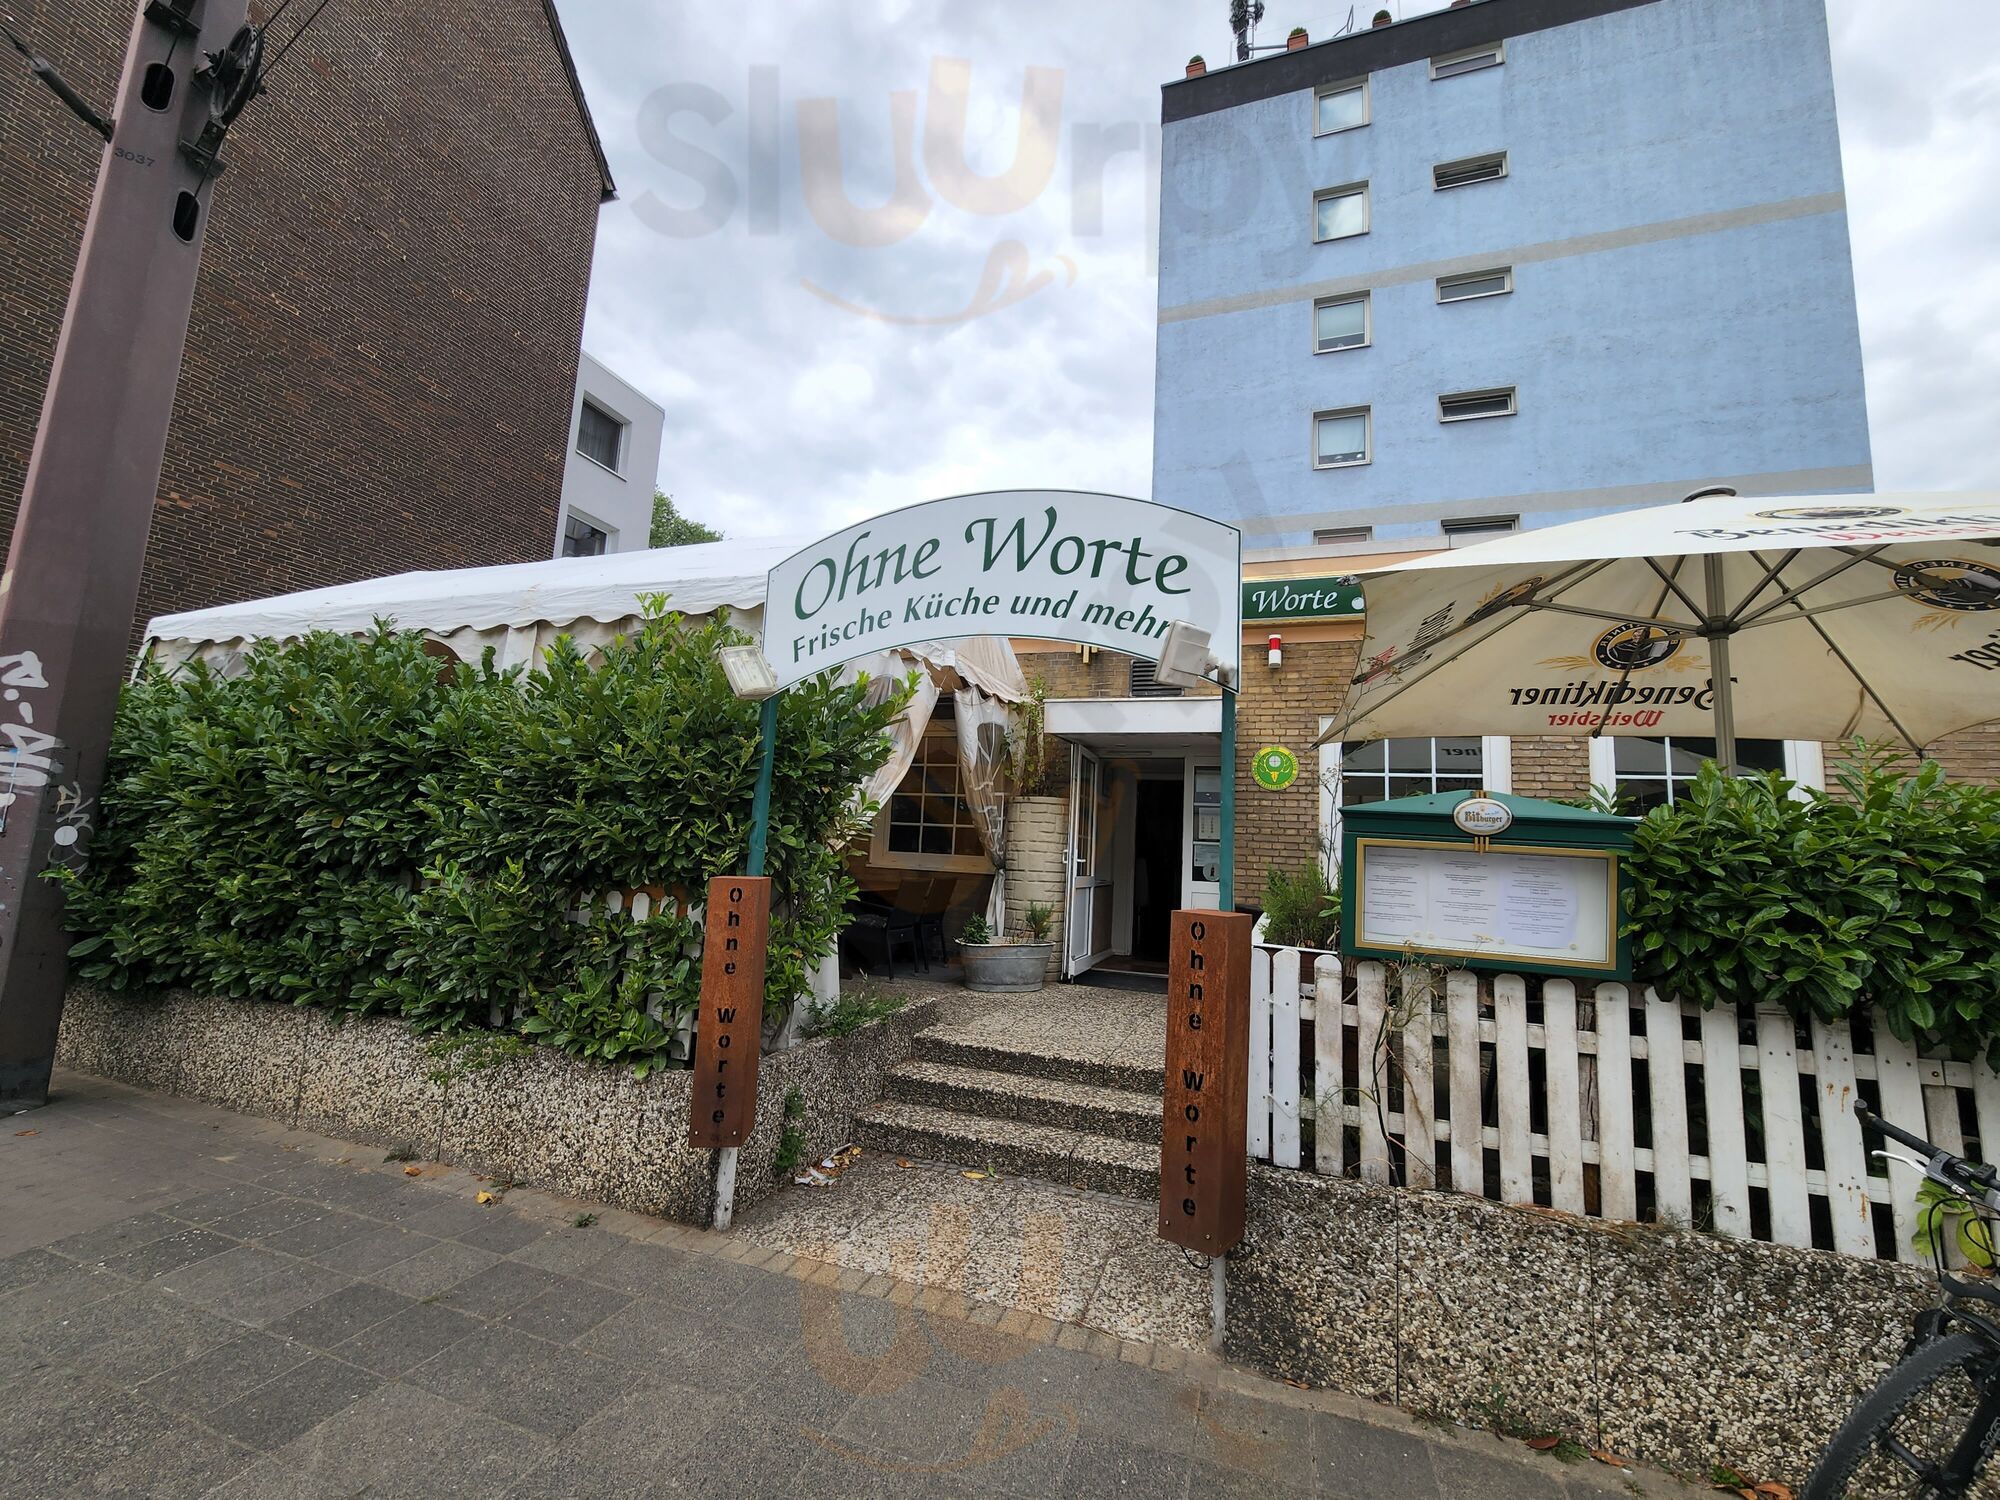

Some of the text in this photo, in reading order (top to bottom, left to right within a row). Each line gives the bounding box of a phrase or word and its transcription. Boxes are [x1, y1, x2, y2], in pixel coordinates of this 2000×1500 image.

[115, 148, 155, 167] 3037
[794, 506, 1191, 620] Ohne Worte
[1252, 585, 1338, 613] Worte
[792, 586, 1170, 663] Frische Küche und mehr
[712, 886, 743, 1124] Ohne Worte
[1182, 920, 1206, 1217] Ohne Worte
